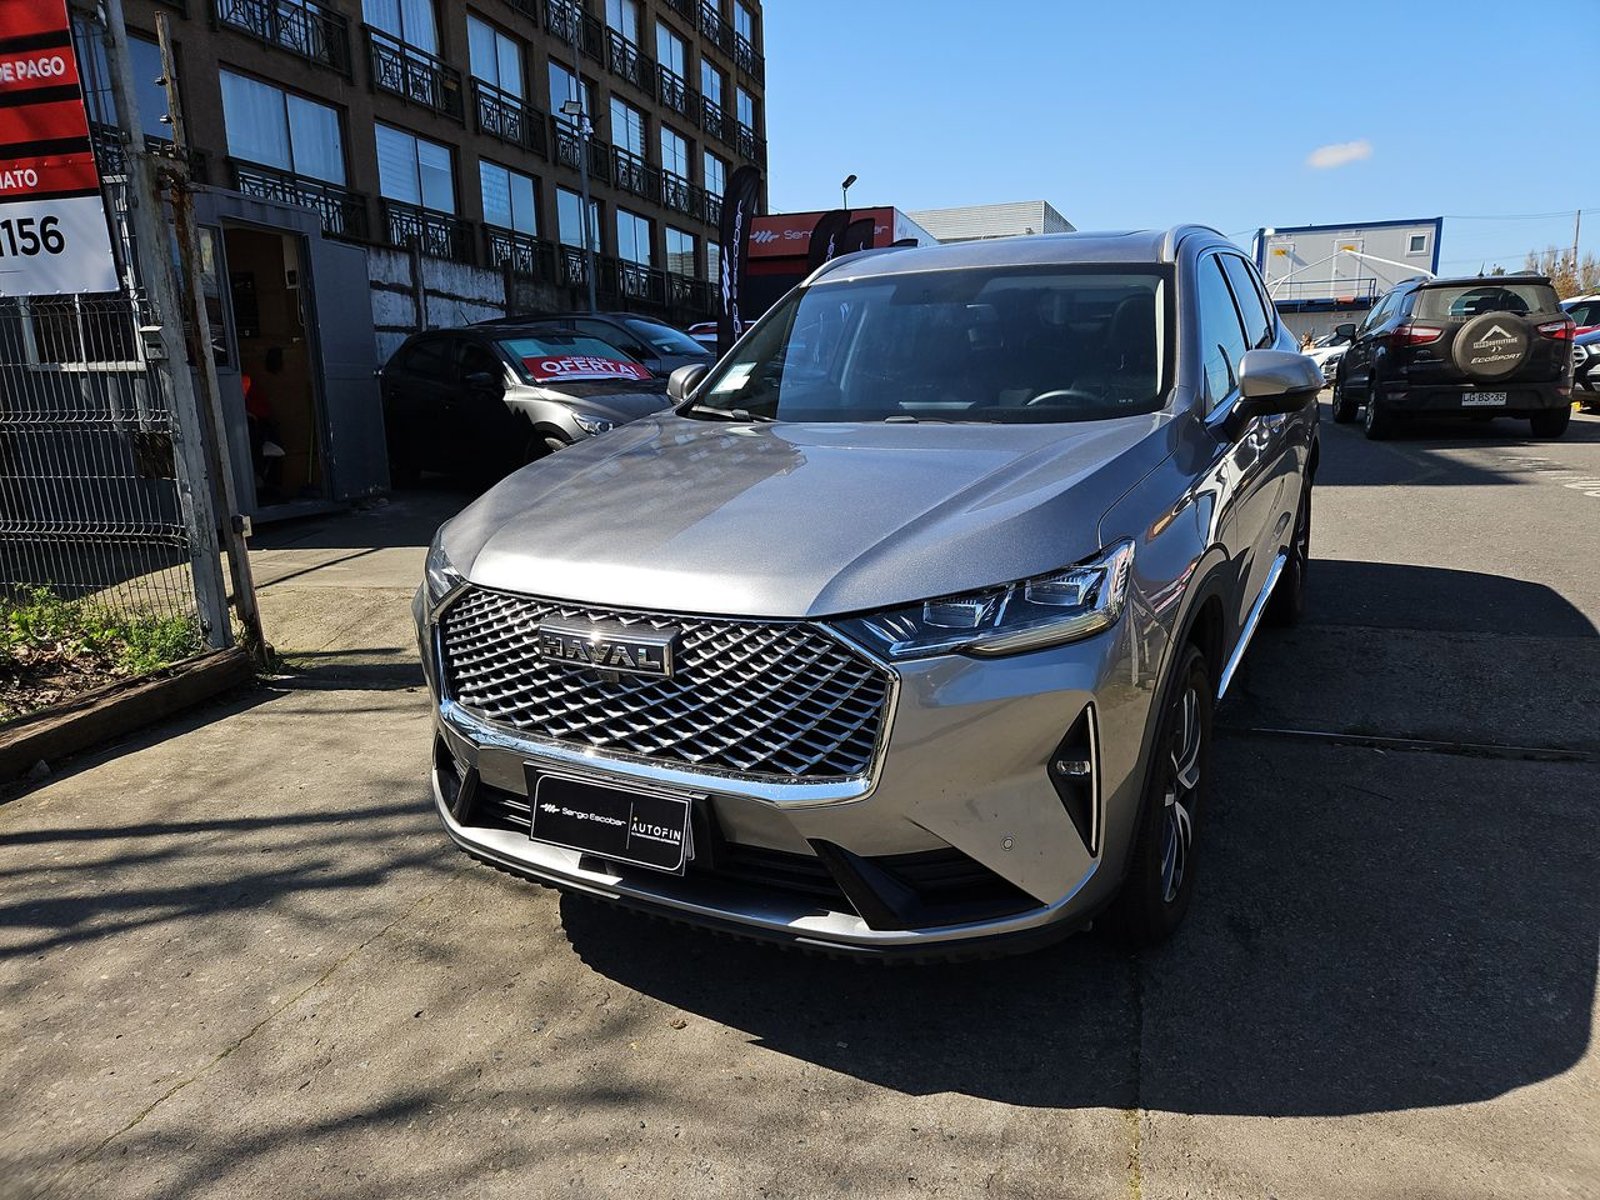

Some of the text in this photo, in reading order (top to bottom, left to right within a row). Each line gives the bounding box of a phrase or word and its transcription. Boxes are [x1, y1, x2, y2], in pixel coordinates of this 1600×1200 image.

[15, 56, 65, 79] PAGO
[0, 169, 38, 189] ATO
[0, 216, 65, 257] 156
[541, 360, 641, 377] OFERTA!
[543, 635, 661, 669] HAVAL
[631, 817, 681, 841] AUTOFIN
